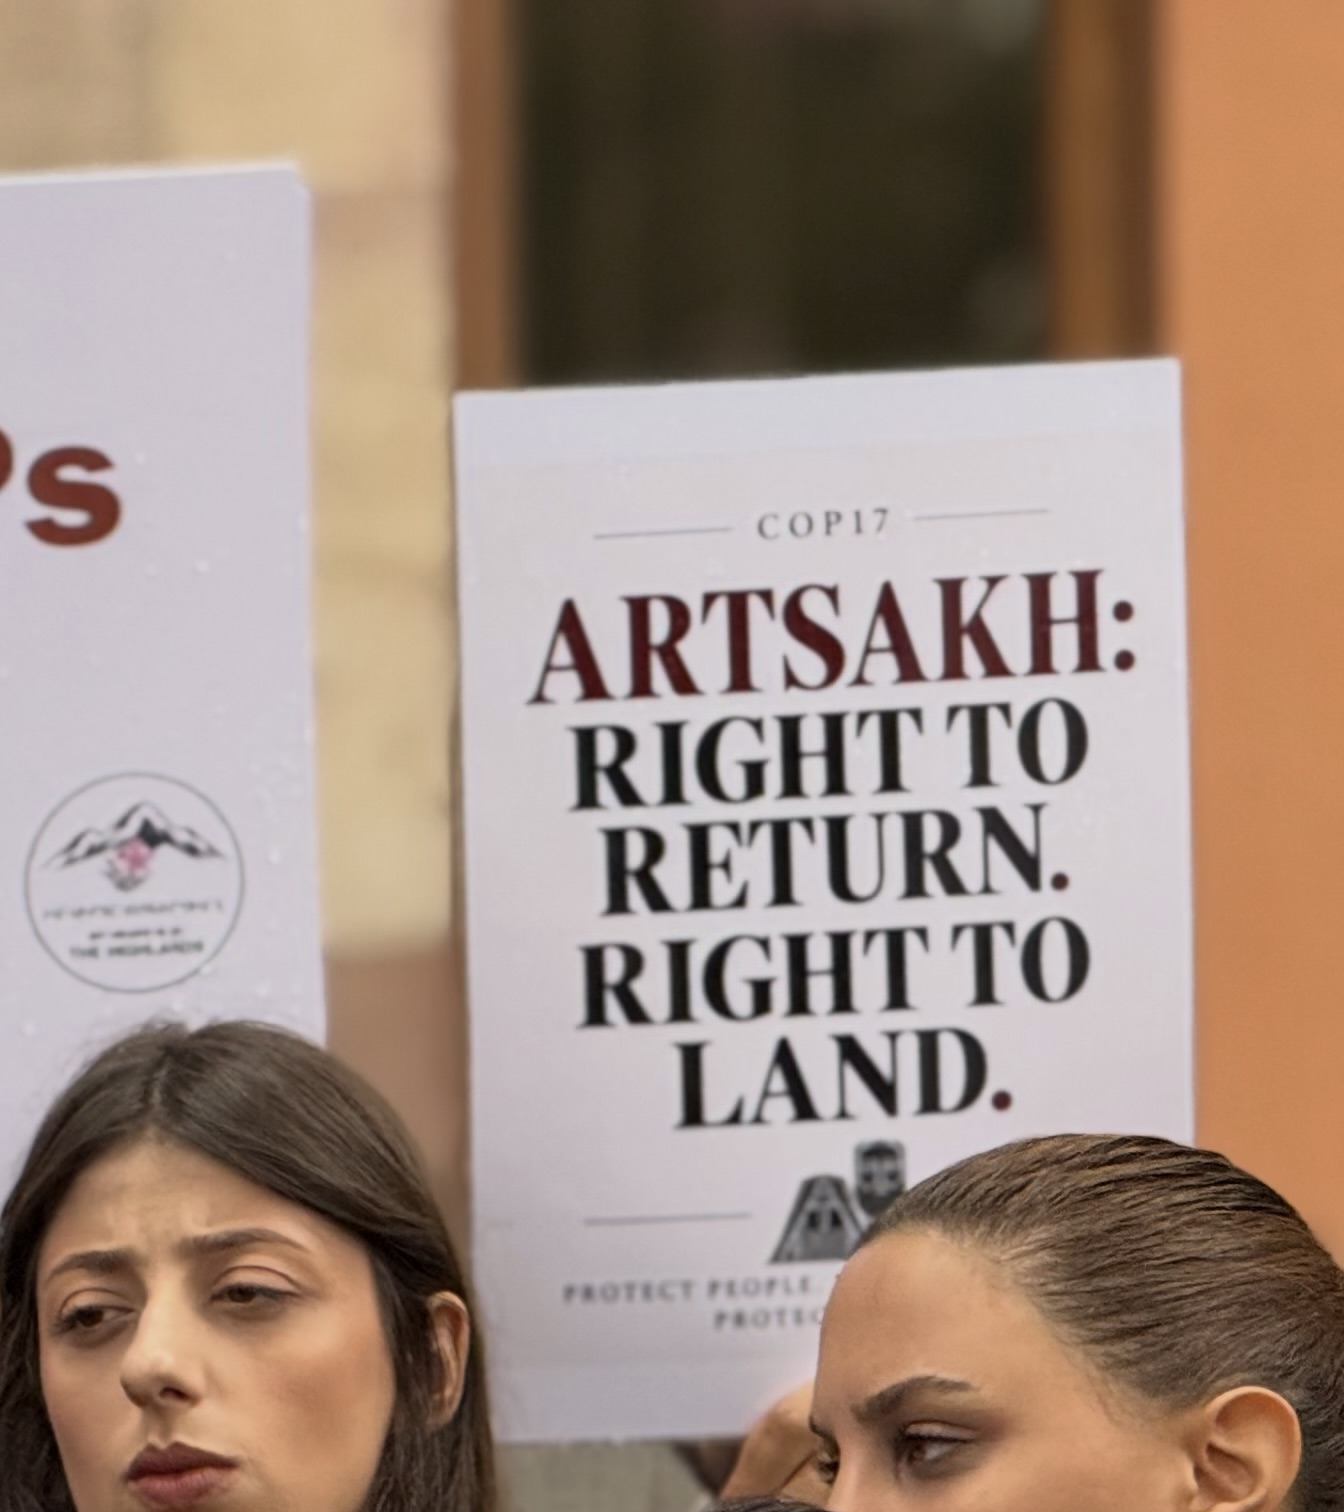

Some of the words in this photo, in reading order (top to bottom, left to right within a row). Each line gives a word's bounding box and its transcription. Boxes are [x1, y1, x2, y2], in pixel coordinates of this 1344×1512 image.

[757, 507, 891, 541] COP17
[525, 568, 1137, 706] ARTSAKH:
[568, 706, 924, 812] RIGHT
[946, 696, 1090, 790] TO
[597, 802, 1071, 918] RETURN.
[576, 926, 930, 1029] RIGHT
[952, 915, 1092, 1008] TO
[673, 1026, 1014, 1130] LAND.
[562, 1279, 694, 1304] PROTECT
